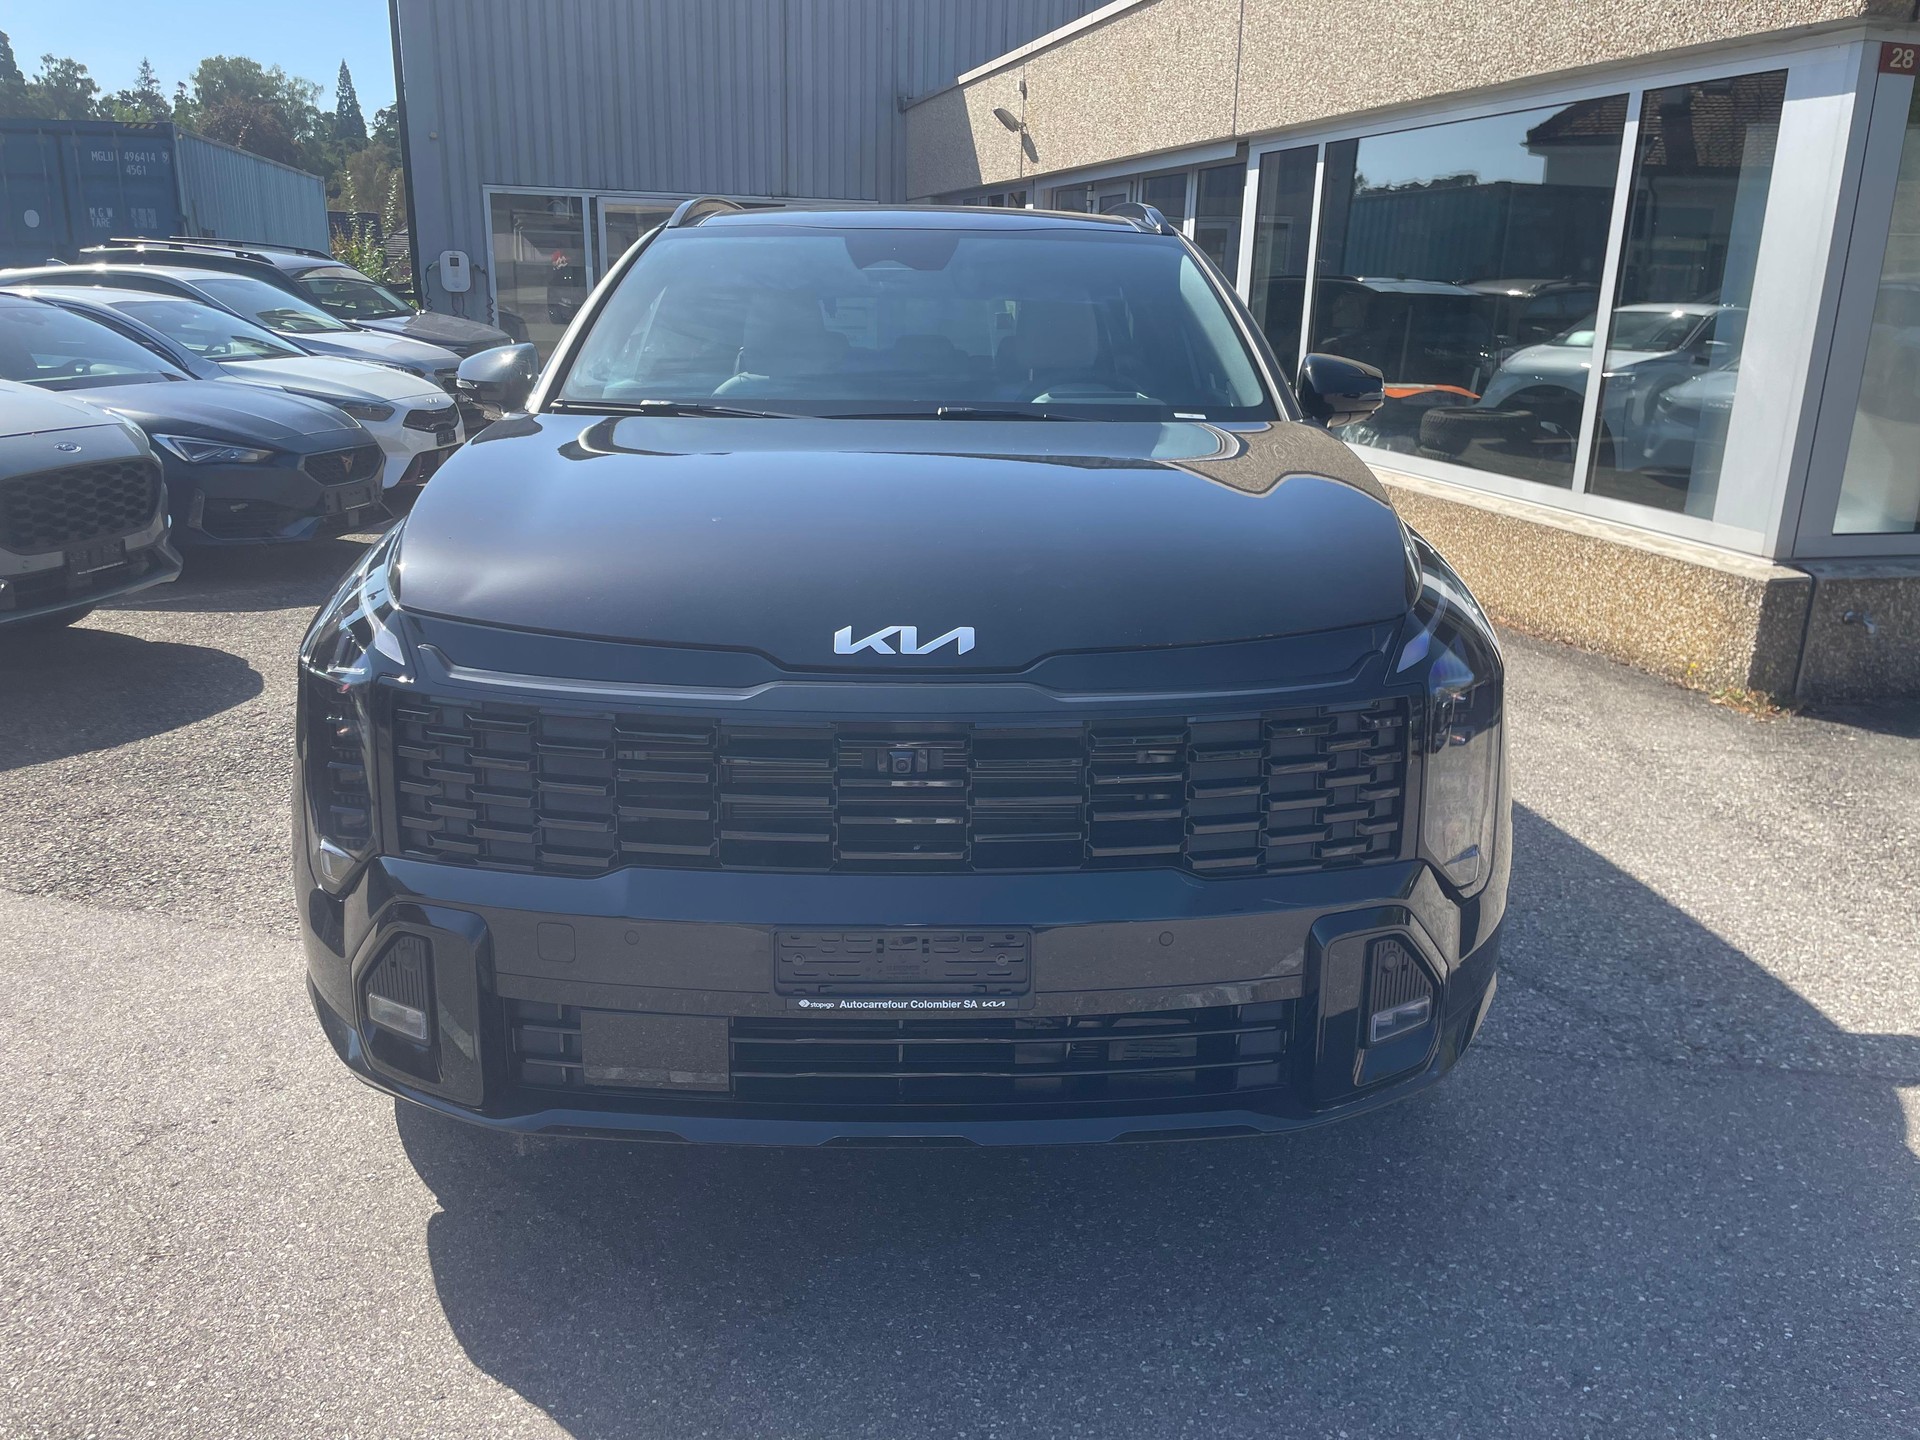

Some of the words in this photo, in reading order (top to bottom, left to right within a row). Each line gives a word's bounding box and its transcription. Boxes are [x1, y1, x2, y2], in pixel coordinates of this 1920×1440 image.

[1889, 47, 1915, 69] 28
[90, 150, 114, 162] MGLU
[124, 151, 156, 163] 496414
[162, 151, 169, 164] 9
[126, 164, 147, 176] 45G1
[91, 217, 111, 228] TARE
[833, 625, 975, 656] KIA
[839, 999, 909, 1009] Autocarrefour
[910, 999, 962, 1009] Colombier
[963, 999, 978, 1009] SA
